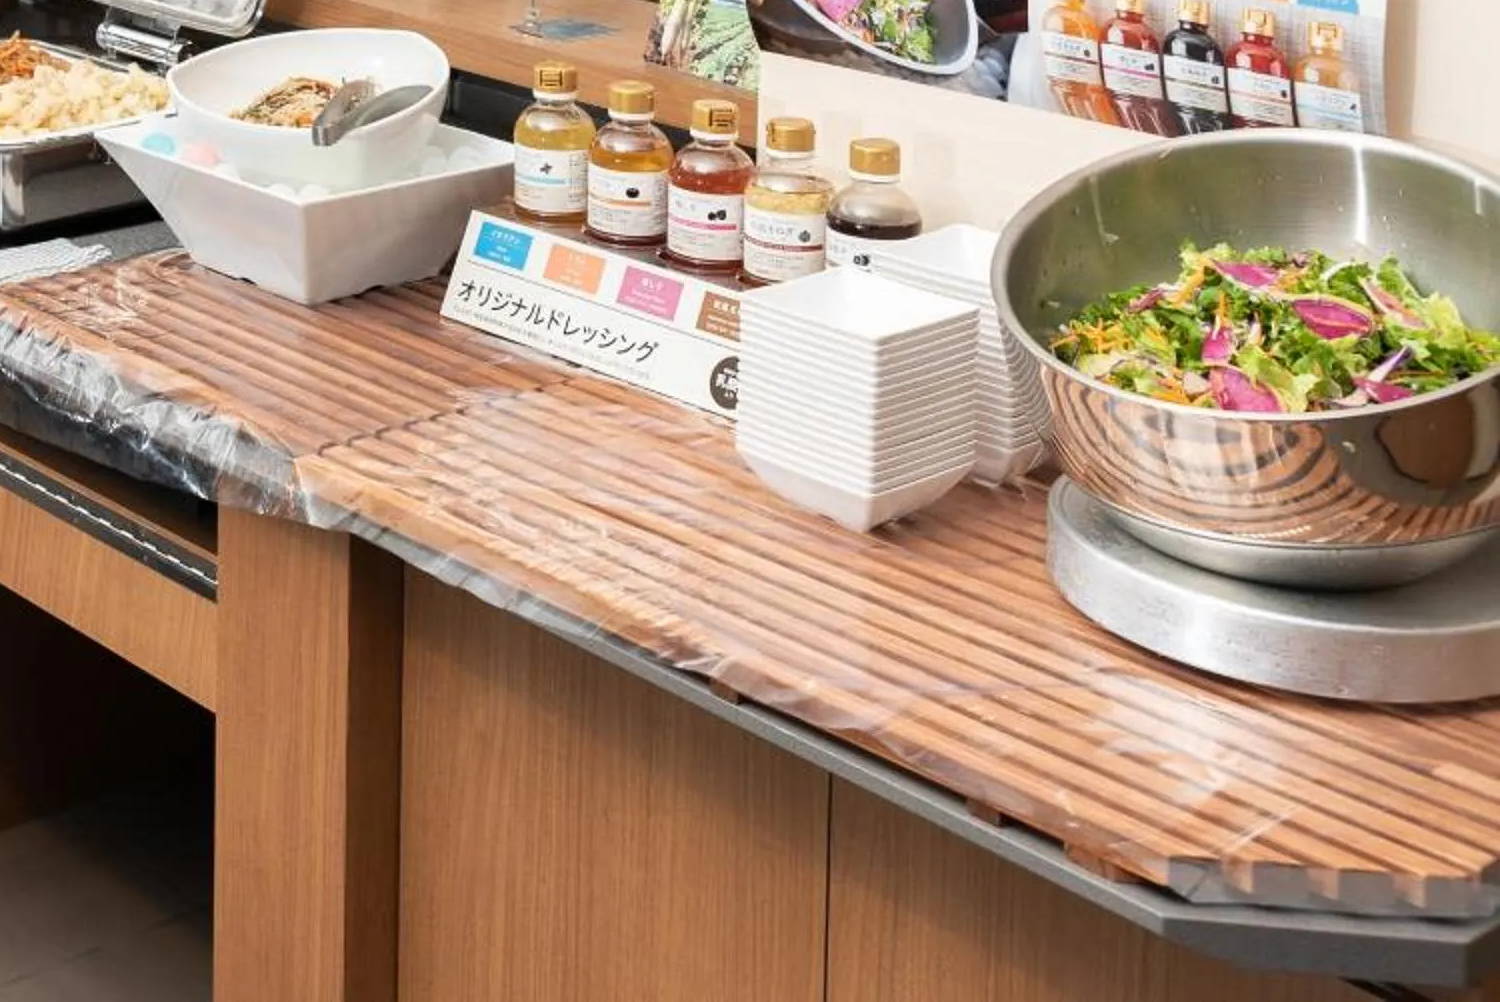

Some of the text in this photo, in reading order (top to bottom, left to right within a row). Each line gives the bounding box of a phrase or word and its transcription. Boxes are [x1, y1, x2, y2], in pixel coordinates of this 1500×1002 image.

[457, 278, 660, 363] オリジナルドレッシング
